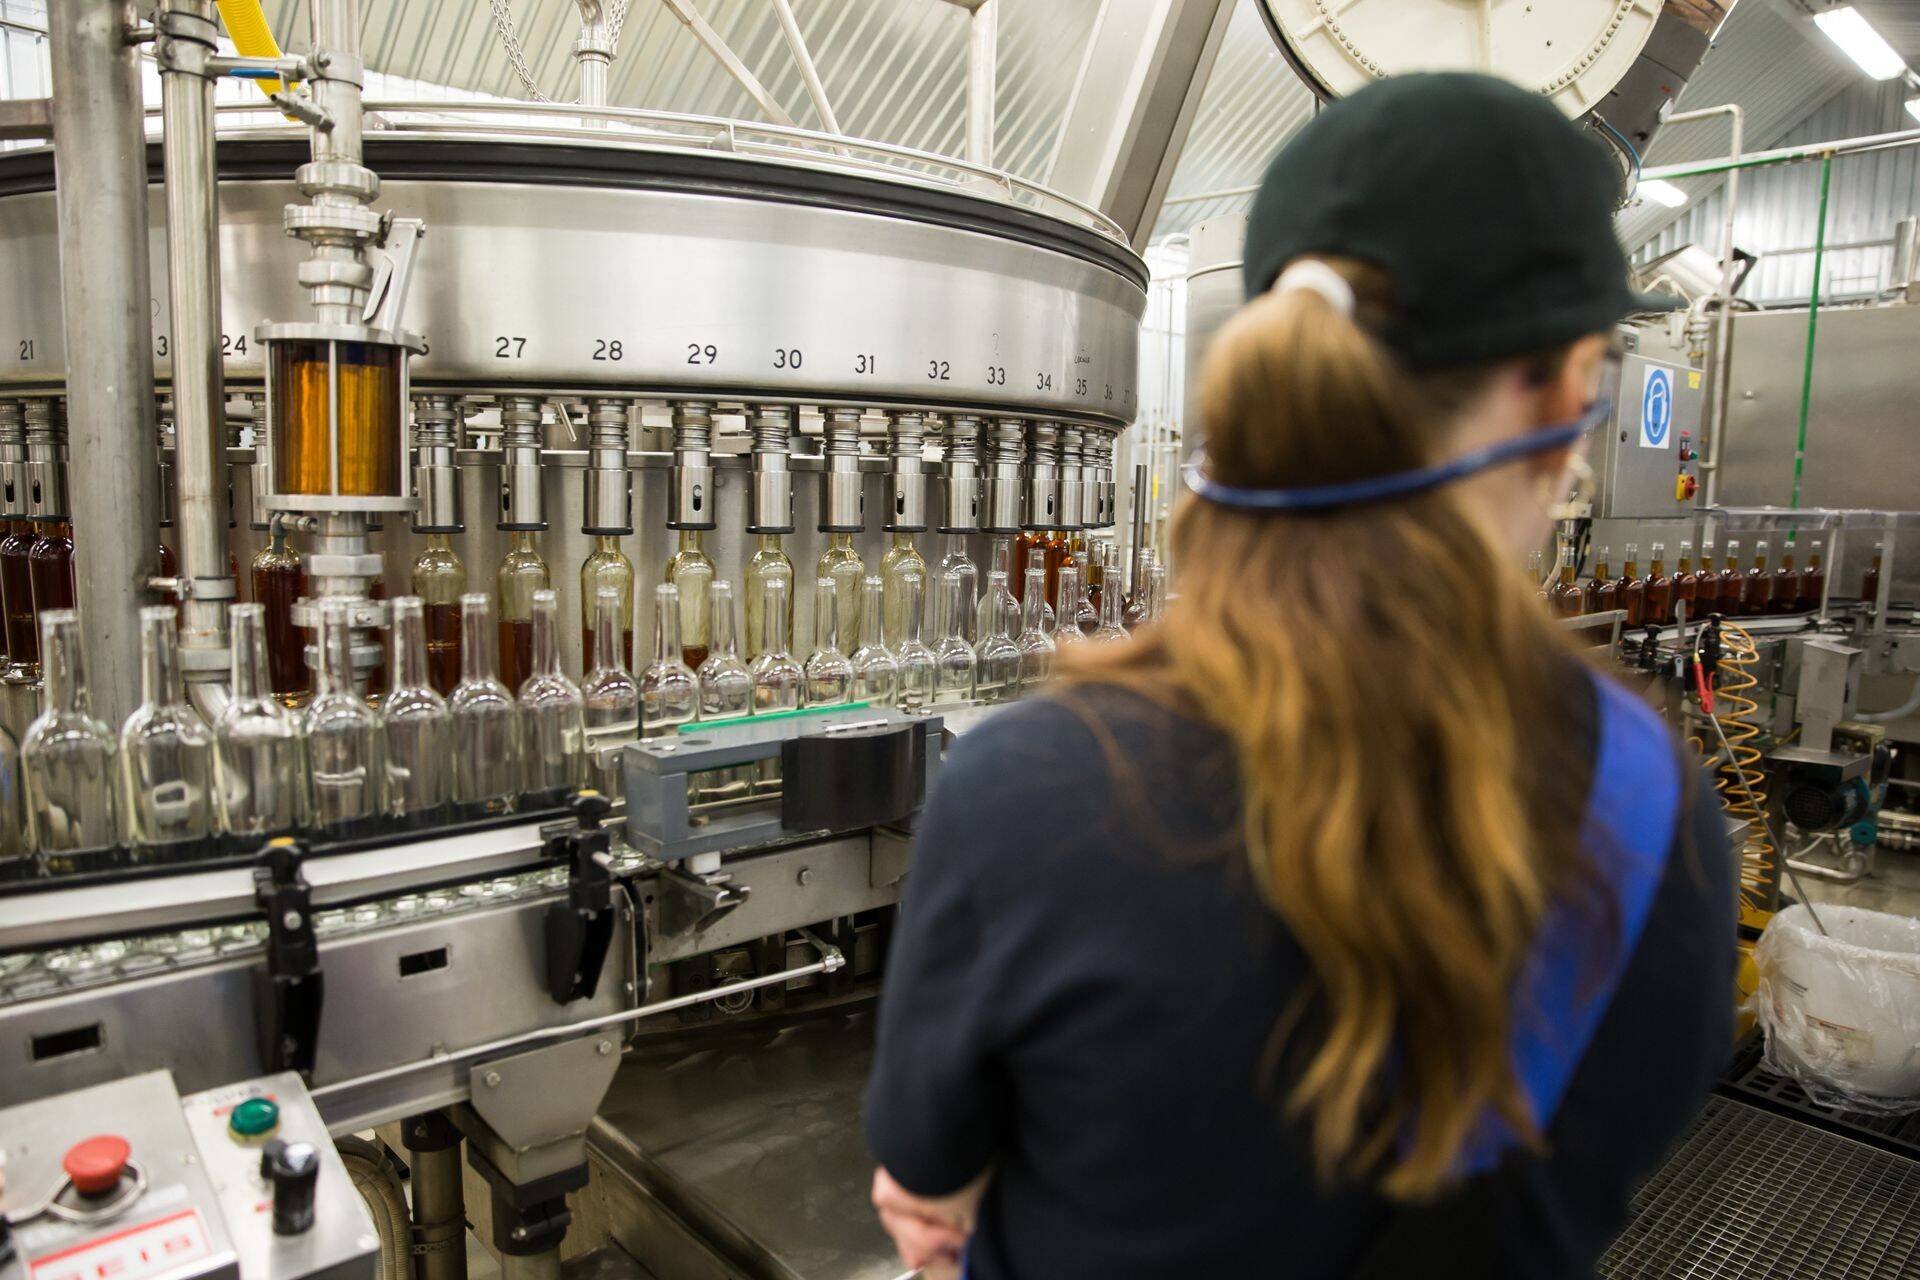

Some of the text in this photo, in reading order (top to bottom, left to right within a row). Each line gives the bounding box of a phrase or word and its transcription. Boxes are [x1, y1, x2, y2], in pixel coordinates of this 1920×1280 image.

[20, 340, 34, 360] 21
[157, 335, 168, 356] 3
[222, 335, 248, 356] 24
[495, 336, 526, 358] 27
[592, 339, 623, 361] 28
[687, 343, 718, 364] 29
[773, 348, 803, 369] 30
[854, 354, 875, 374] 31
[927, 360, 951, 380] 32
[986, 366, 1006, 386] 33
[1036, 372, 1052, 391] 34
[1075, 378, 1088, 396] 35
[1103, 383, 1114, 401] 36
